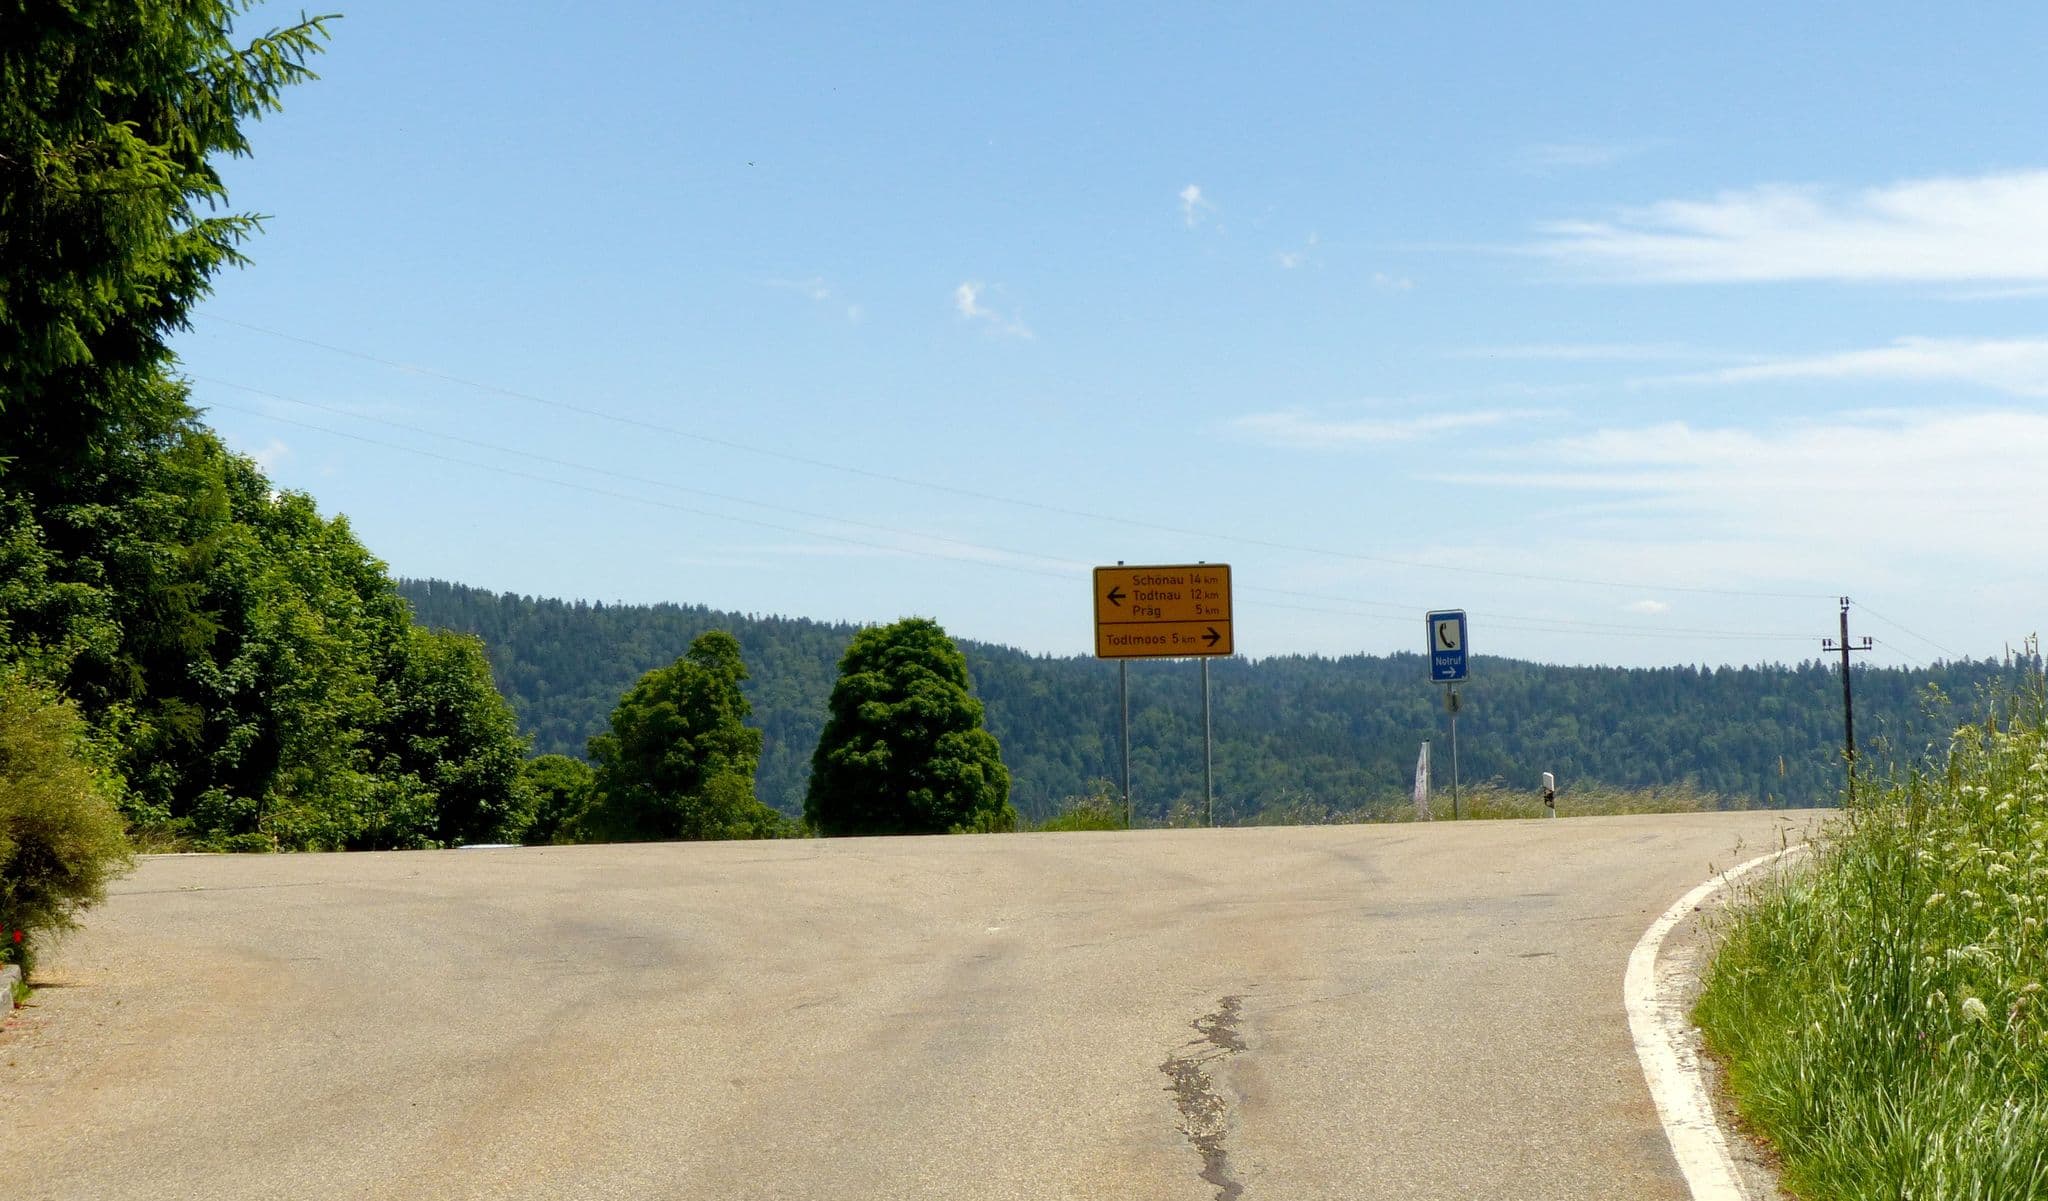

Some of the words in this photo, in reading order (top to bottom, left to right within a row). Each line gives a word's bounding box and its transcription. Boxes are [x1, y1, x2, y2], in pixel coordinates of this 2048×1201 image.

[1189, 573, 1201, 585] 14
[1204, 575, 1218, 584] km
[1132, 590, 1181, 600] Todtnau
[1190, 589, 1202, 600] 12
[1204, 590, 1219, 599] km
[1132, 605, 1161, 618] Präg
[1195, 604, 1203, 615] 5
[1205, 606, 1219, 614] km
[1106, 634, 1166, 645] Todtmoos
[1172, 633, 1179, 644] 5
[1181, 635, 1196, 643] km
[1435, 656, 1462, 666] Notruf
